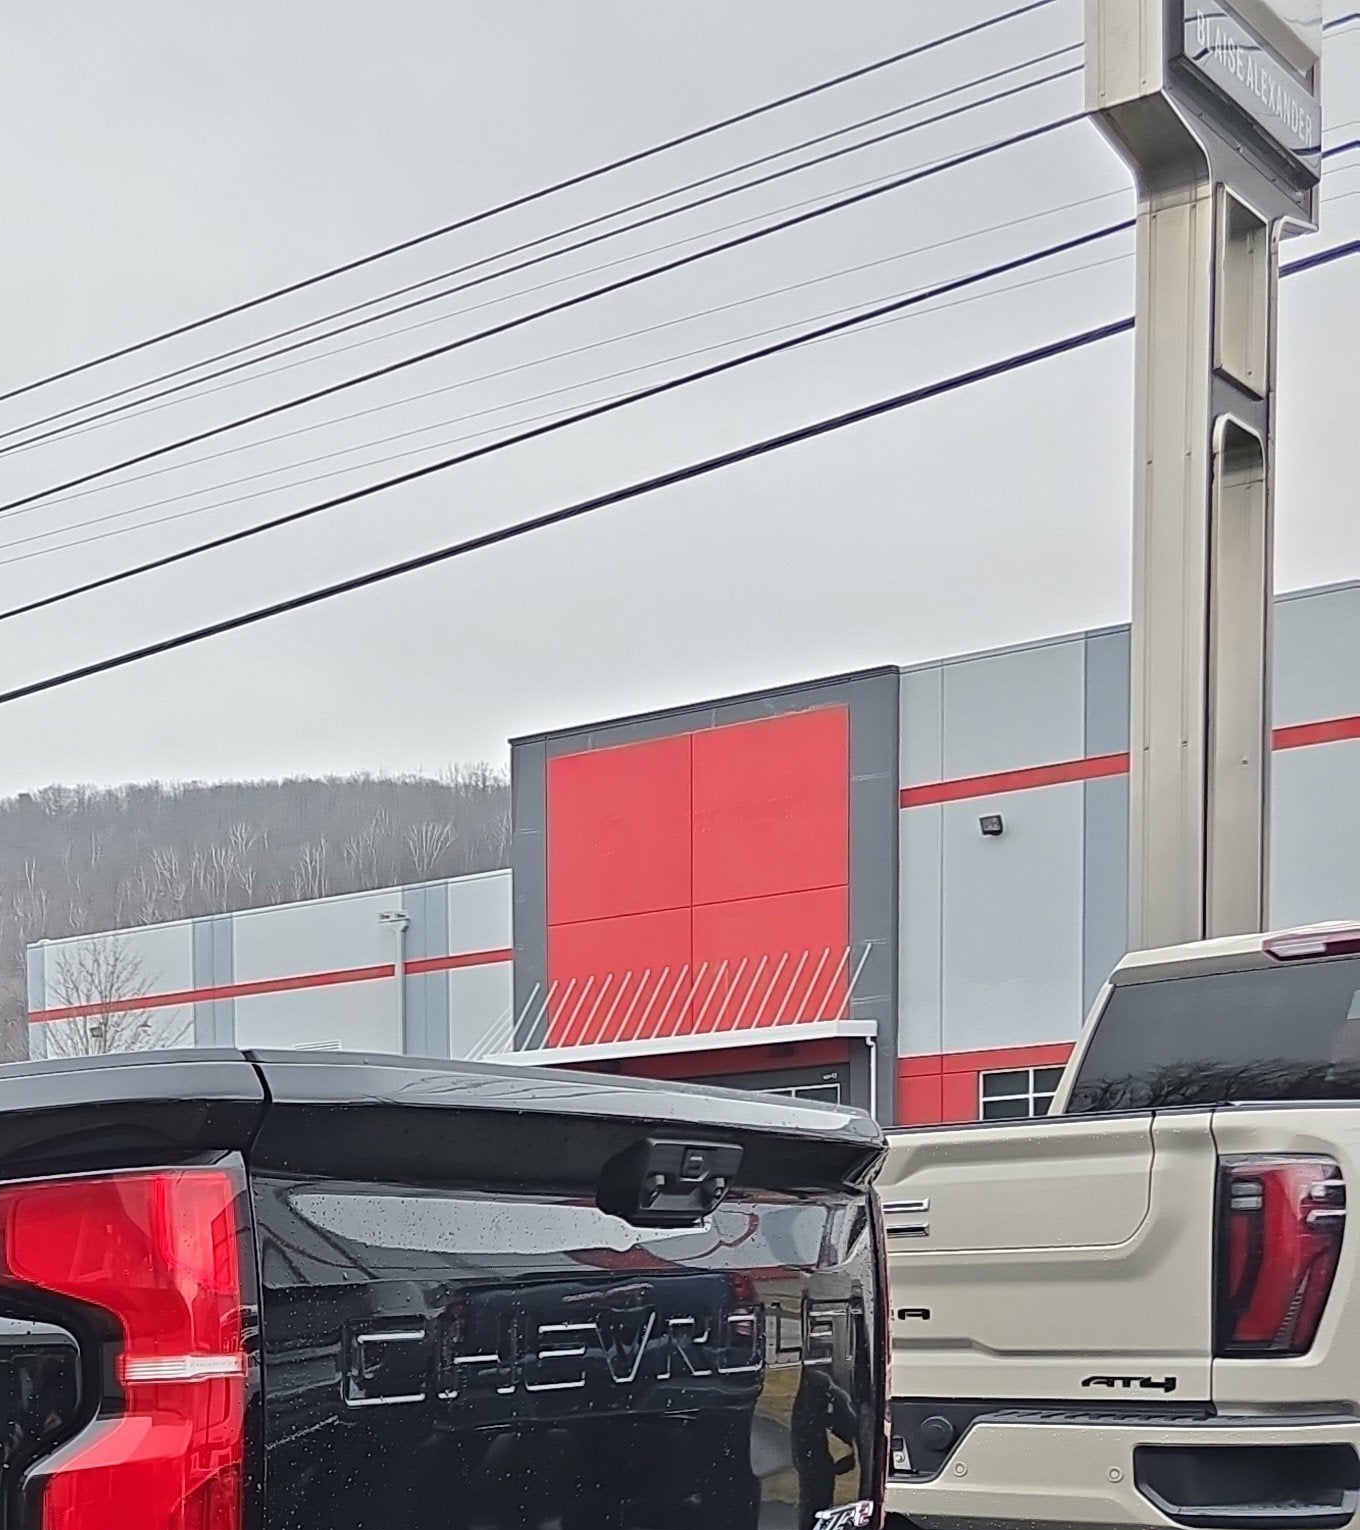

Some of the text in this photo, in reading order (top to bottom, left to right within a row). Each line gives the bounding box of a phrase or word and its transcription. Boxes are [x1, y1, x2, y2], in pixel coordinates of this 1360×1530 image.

[1196, 9, 1313, 145] BLAISE ALEXANDER
[342, 1298, 864, 1407] CHEVROLET
[1081, 1375, 1177, 1393] AT4
